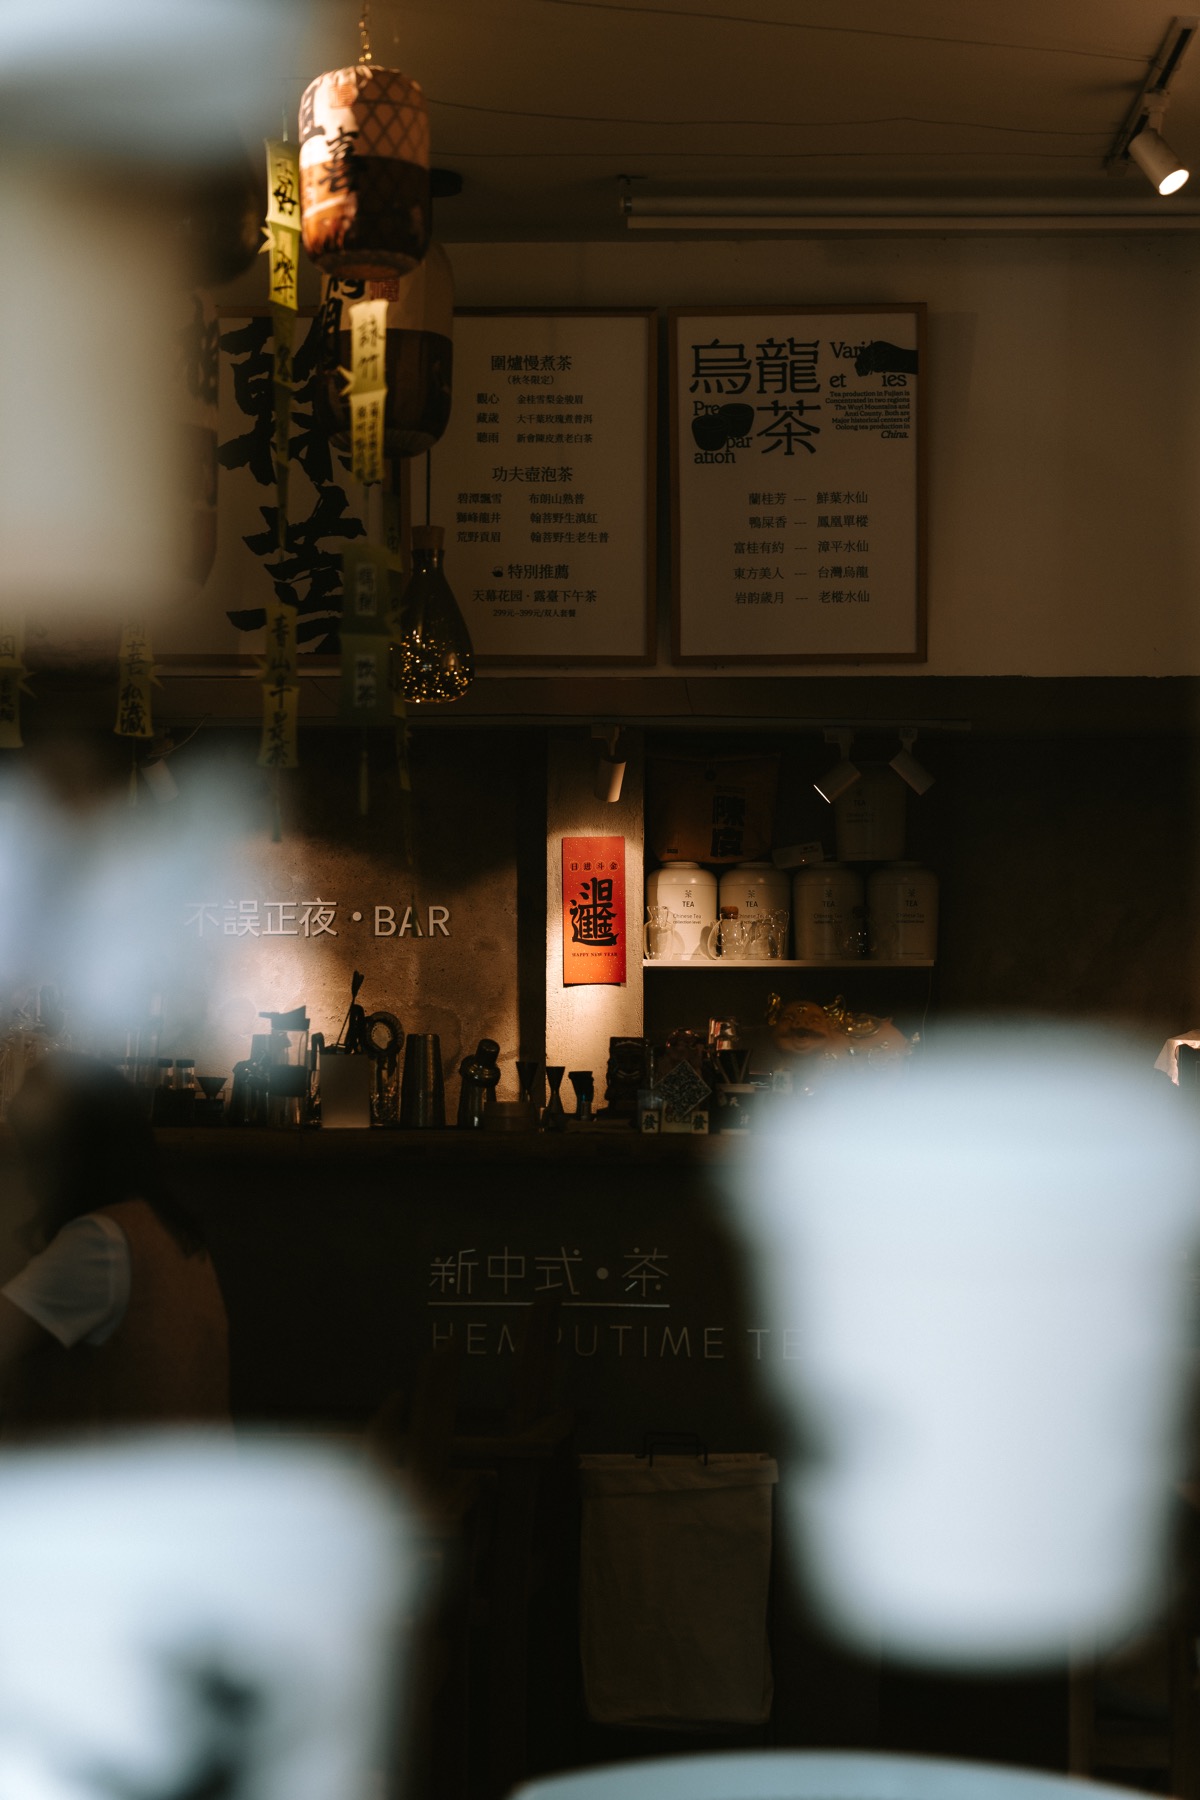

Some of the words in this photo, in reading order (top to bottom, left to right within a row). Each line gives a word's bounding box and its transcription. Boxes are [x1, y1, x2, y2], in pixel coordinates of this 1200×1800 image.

[491, 355, 572, 371] 圍爐慢煮茶
[689, 337, 821, 394] 烏龍
[829, 373, 846, 387] et
[882, 373, 907, 387] ies
[757, 400, 821, 455] 茶
[517, 433, 592, 443] 新會陳皮煮老白茶
[725, 436, 752, 452] par
[492, 466, 573, 482] 功夫壺泡茶
[457, 493, 502, 504] 碧潭飄雪
[749, 492, 786, 505] 蘭桂芳
[816, 491, 868, 504] 鮮葉水仙
[456, 512, 501, 523] 獅峰龍井
[749, 516, 786, 528] 鴨屎香
[457, 532, 501, 543] 荒野貢眉
[734, 542, 784, 554] 富桂有約
[818, 540, 868, 553] 漳平水仙
[734, 567, 784, 580] 東方美人
[818, 566, 868, 579] 台灣烏龍
[432, 1322, 725, 1358] HEAUTIME
